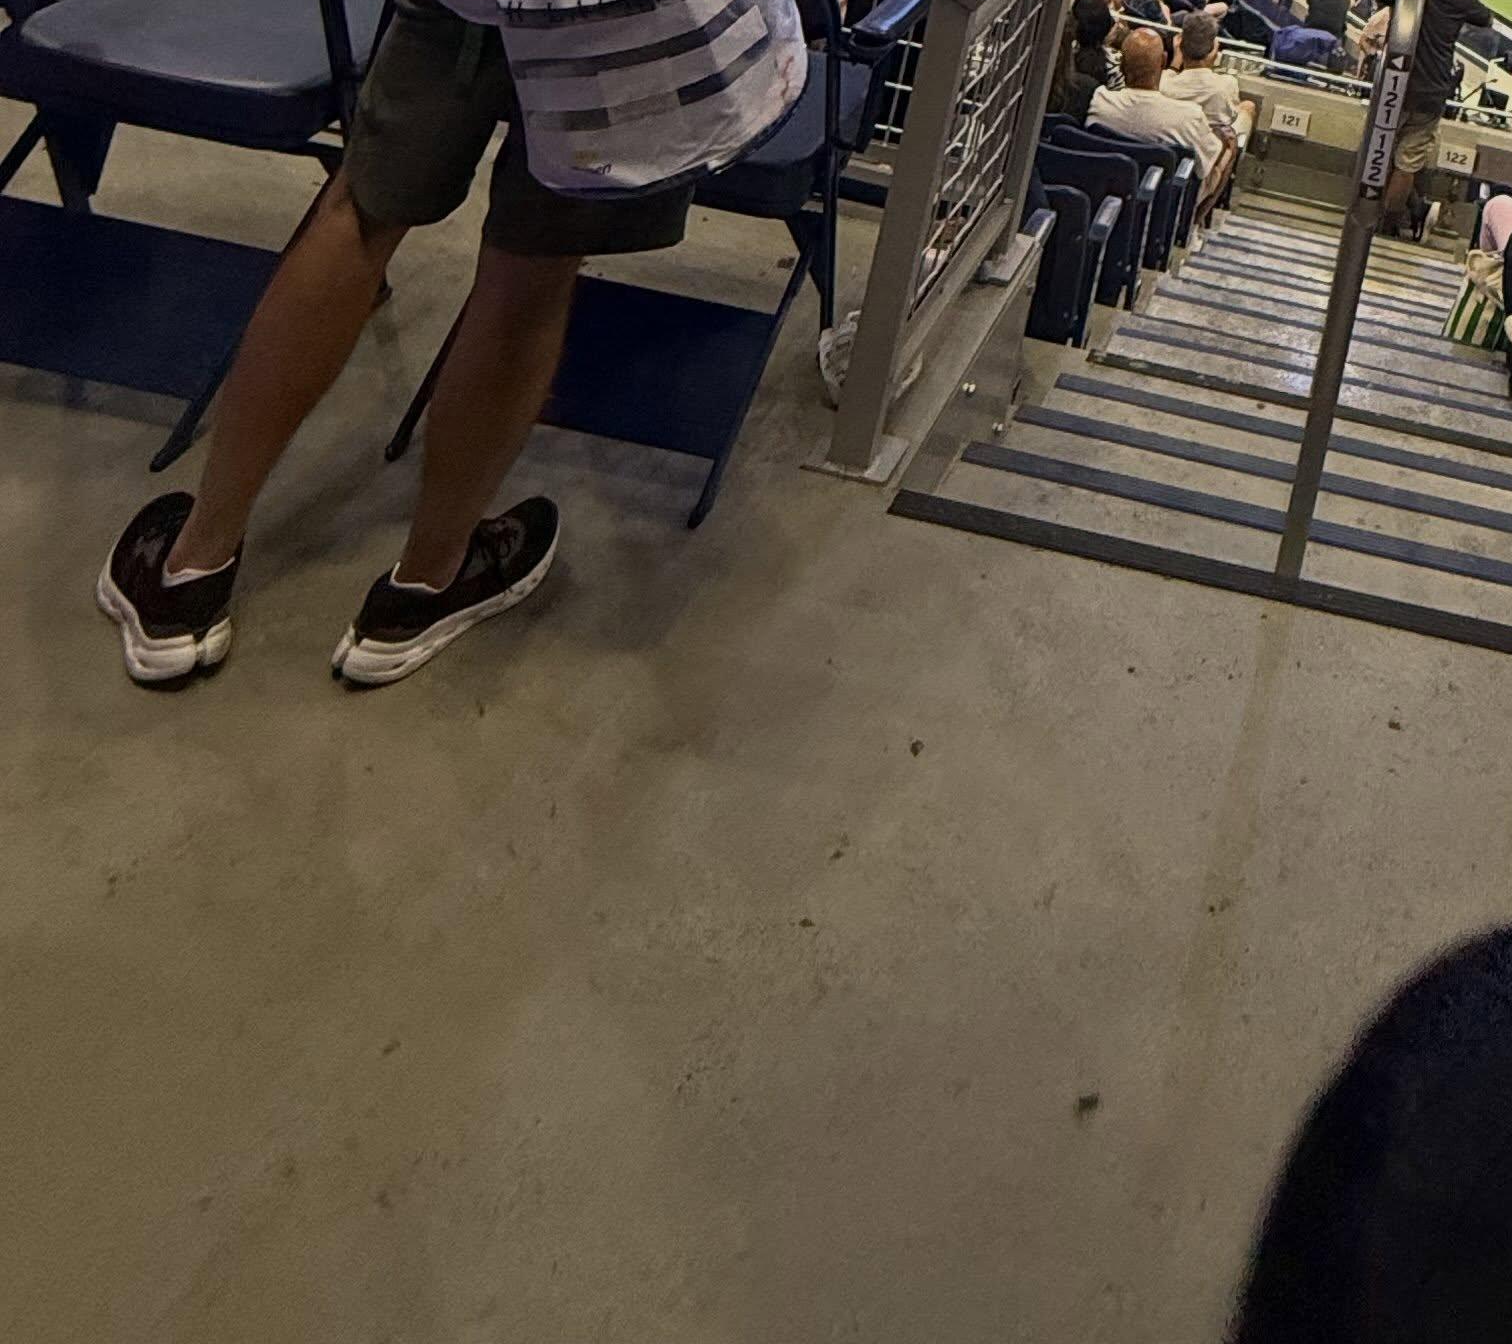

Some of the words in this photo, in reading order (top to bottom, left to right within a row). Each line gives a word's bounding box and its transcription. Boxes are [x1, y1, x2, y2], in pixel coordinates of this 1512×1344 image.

[1383, 75, 1400, 125] 121
[1281, 114, 1301, 128] 121
[1367, 134, 1386, 182] 122
[1445, 151, 1468, 166] 122
